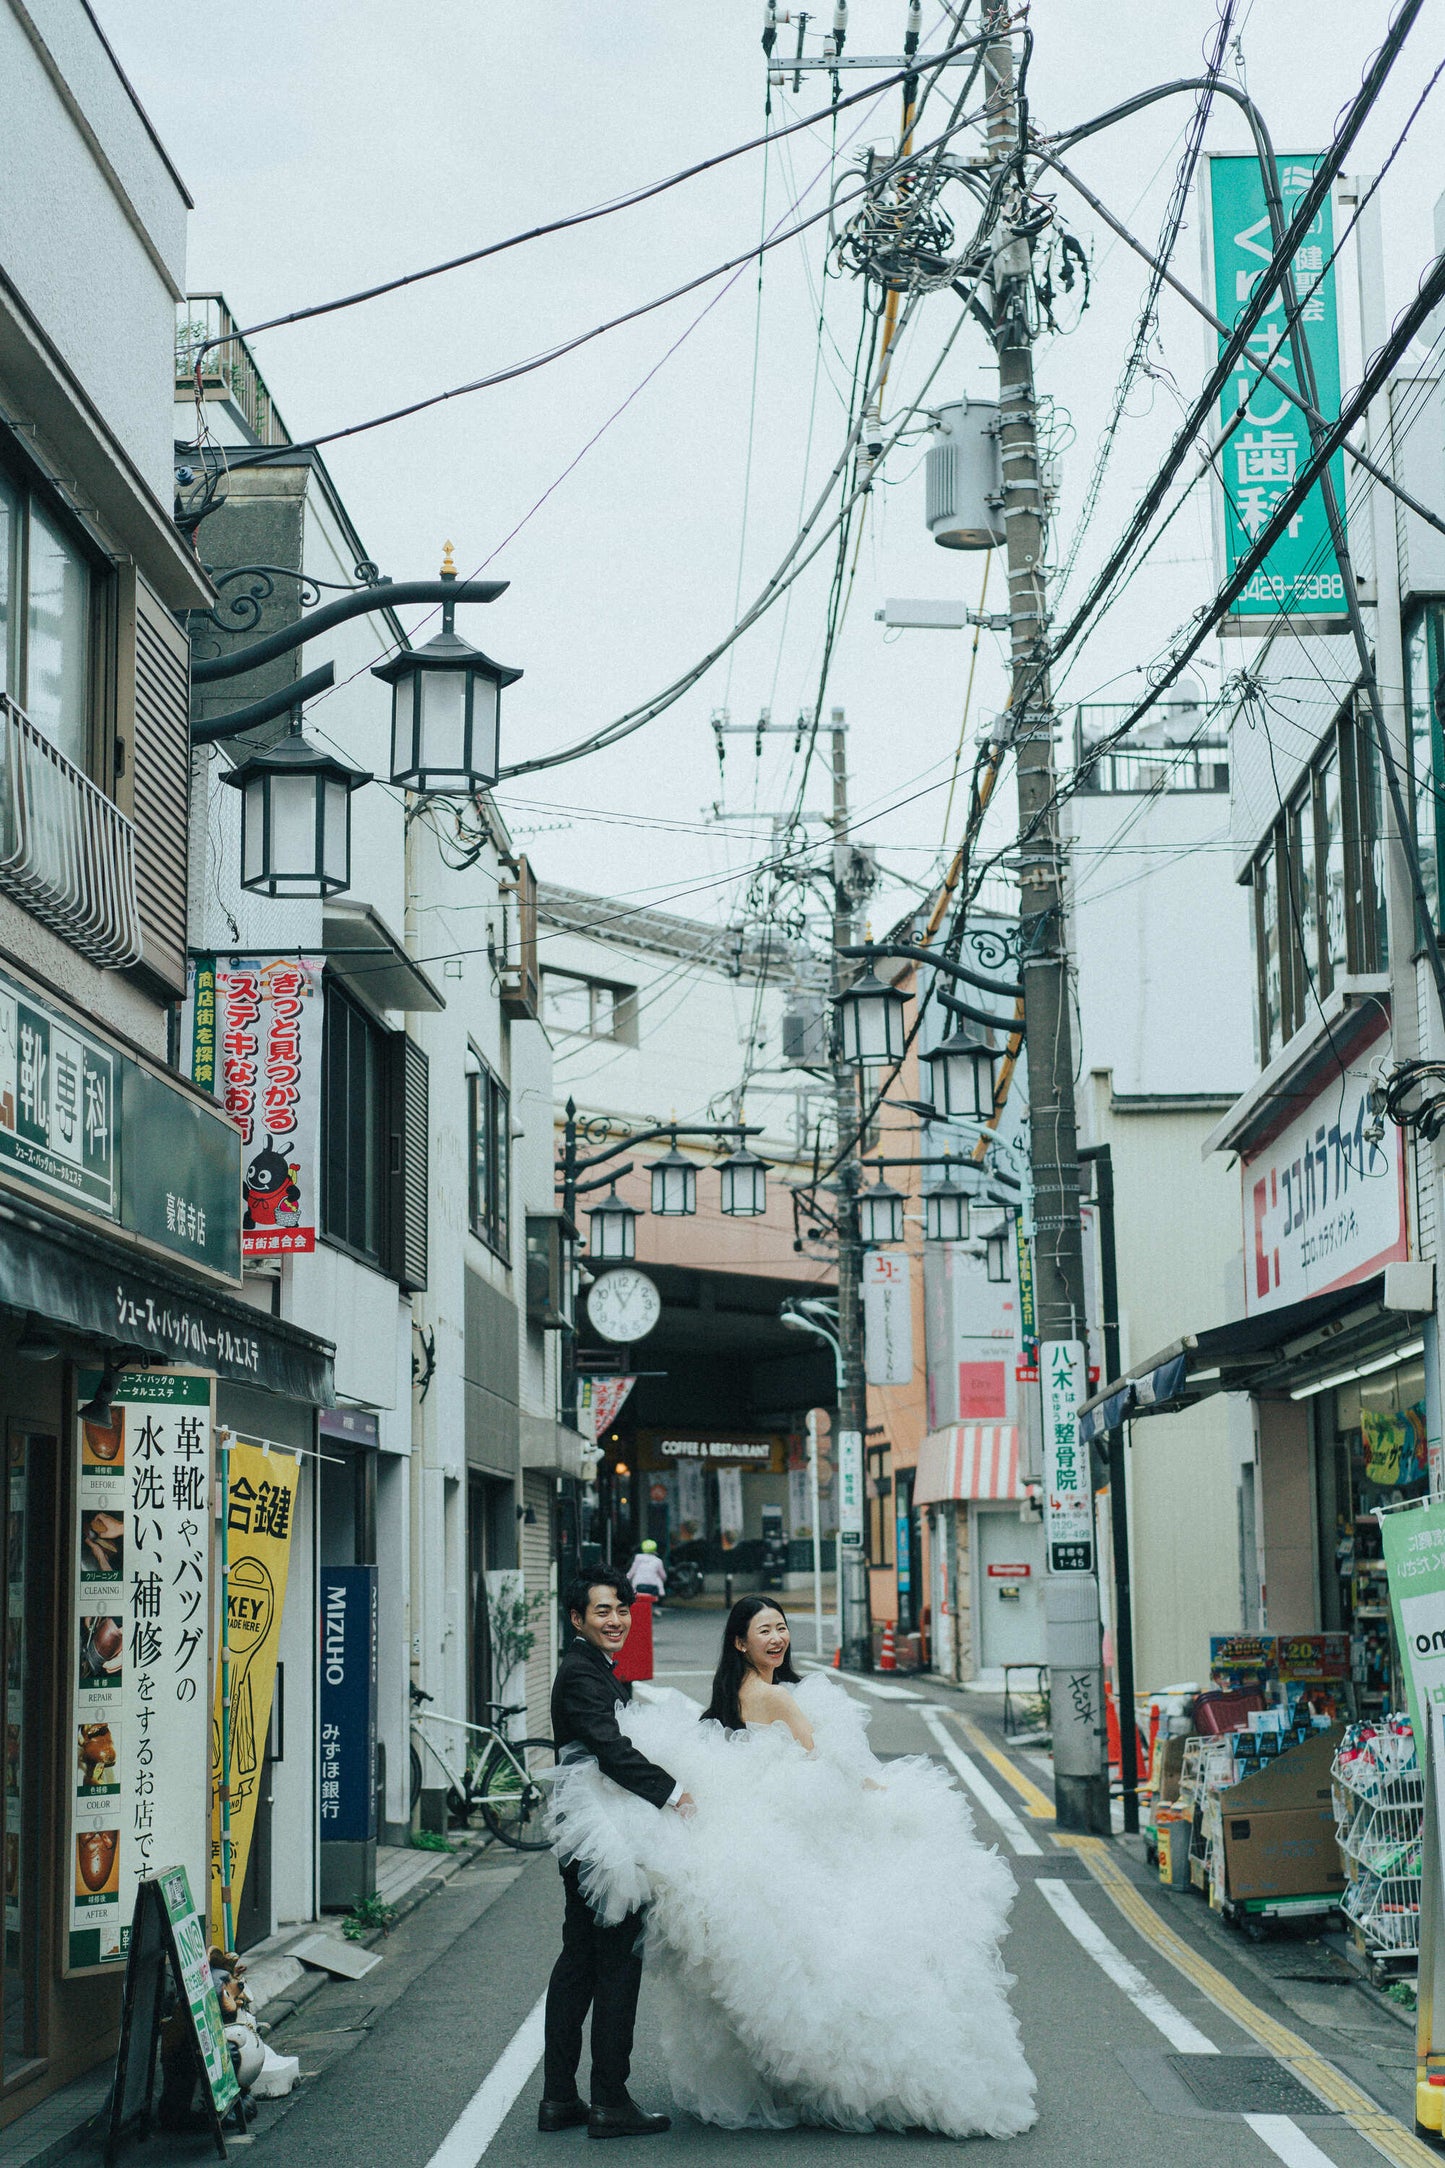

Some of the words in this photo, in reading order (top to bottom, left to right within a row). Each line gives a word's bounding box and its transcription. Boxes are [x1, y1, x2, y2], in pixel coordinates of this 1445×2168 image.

[263, 971, 304, 1134] きっと見つかる
[1052, 1346, 1073, 1391] 八木
[122, 1375, 175, 1385] ューズ・バッグの
[661, 1440, 699, 1456] COFFEE
[1054, 1423, 1078, 1491] 整骨院
[90, 1479, 117, 1490] BEFORE
[228, 1476, 291, 1539] 合鍵
[172, 1415, 206, 1703] 革靴やバッグの
[1059, 1558, 1085, 1568] 1-45
[84, 1586, 120, 1596] CLEANING
[228, 1595, 264, 1621] KEY
[242, 1620, 261, 1633] HERE
[326, 1586, 346, 1686] MIZUHO
[128, 1415, 165, 1882] 水洗い、補修をするお店です
[88, 1693, 113, 1703] REPAIR
[321, 1723, 340, 1819] みずほ銀行
[86, 1799, 111, 1810] COLOR
[85, 1908, 109, 1919] AFTER
